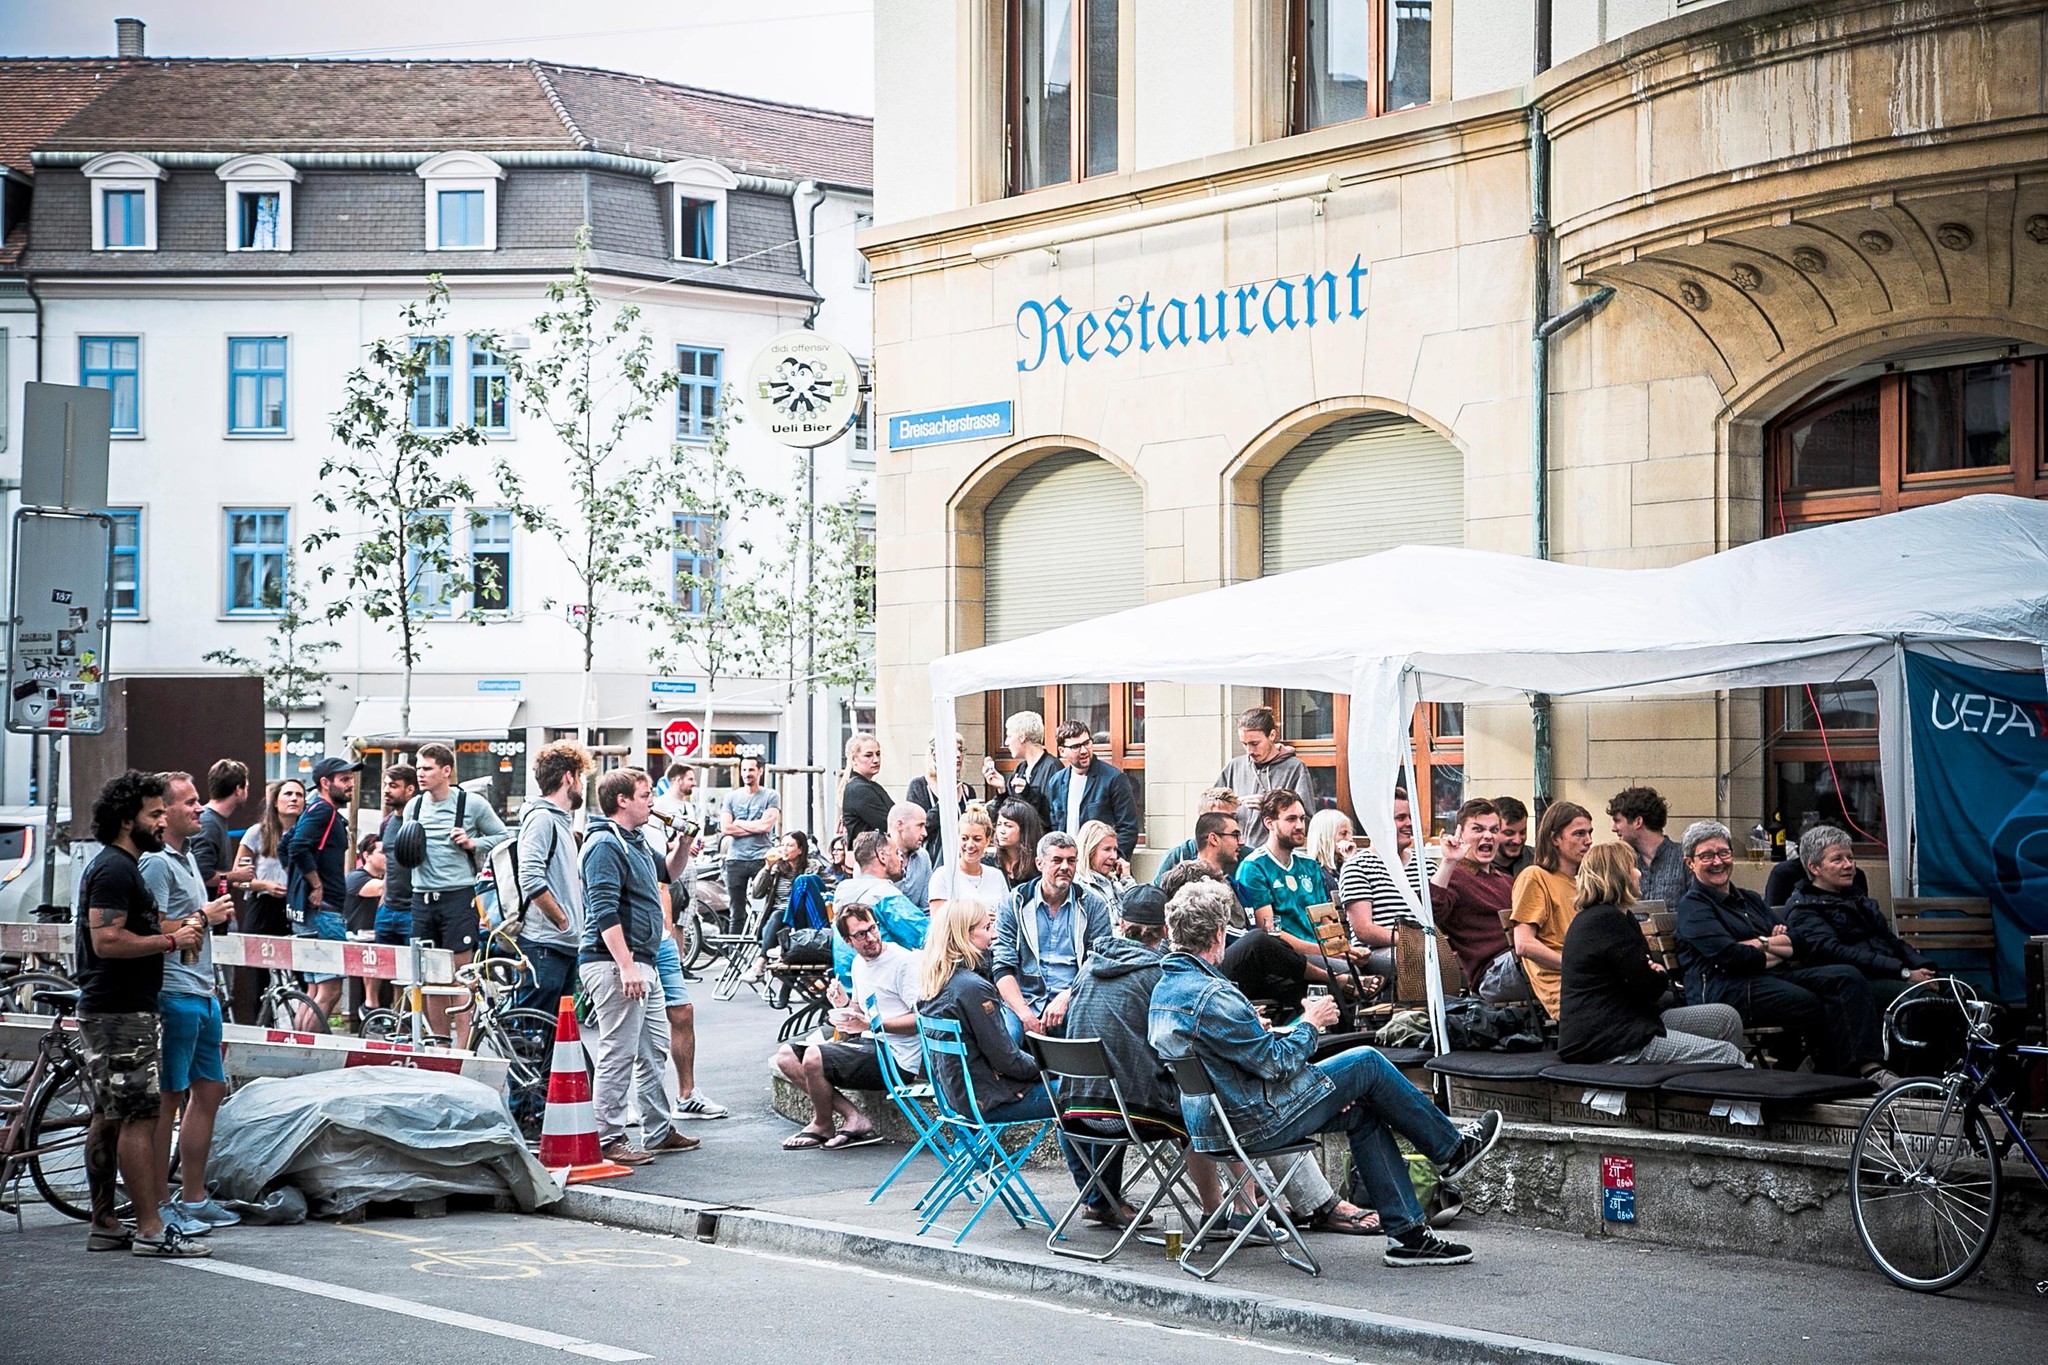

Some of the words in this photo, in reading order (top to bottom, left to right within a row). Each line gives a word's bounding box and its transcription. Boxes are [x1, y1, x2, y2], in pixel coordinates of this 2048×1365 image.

[1015, 252, 1368, 373] Restaurant
[771, 344, 789, 353] didi
[791, 343, 830, 353] offensiv
[771, 424, 798, 433] Ueli
[803, 423, 832, 432] Bier
[899, 410, 1001, 440] Breisacherstrasse
[55, 591, 71, 601] 187
[1931, 688, 2036, 737] UEFA
[666, 731, 696, 746] STOP
[361, 946, 378, 965] ab
[1605, 1188, 1610, 1198] S
